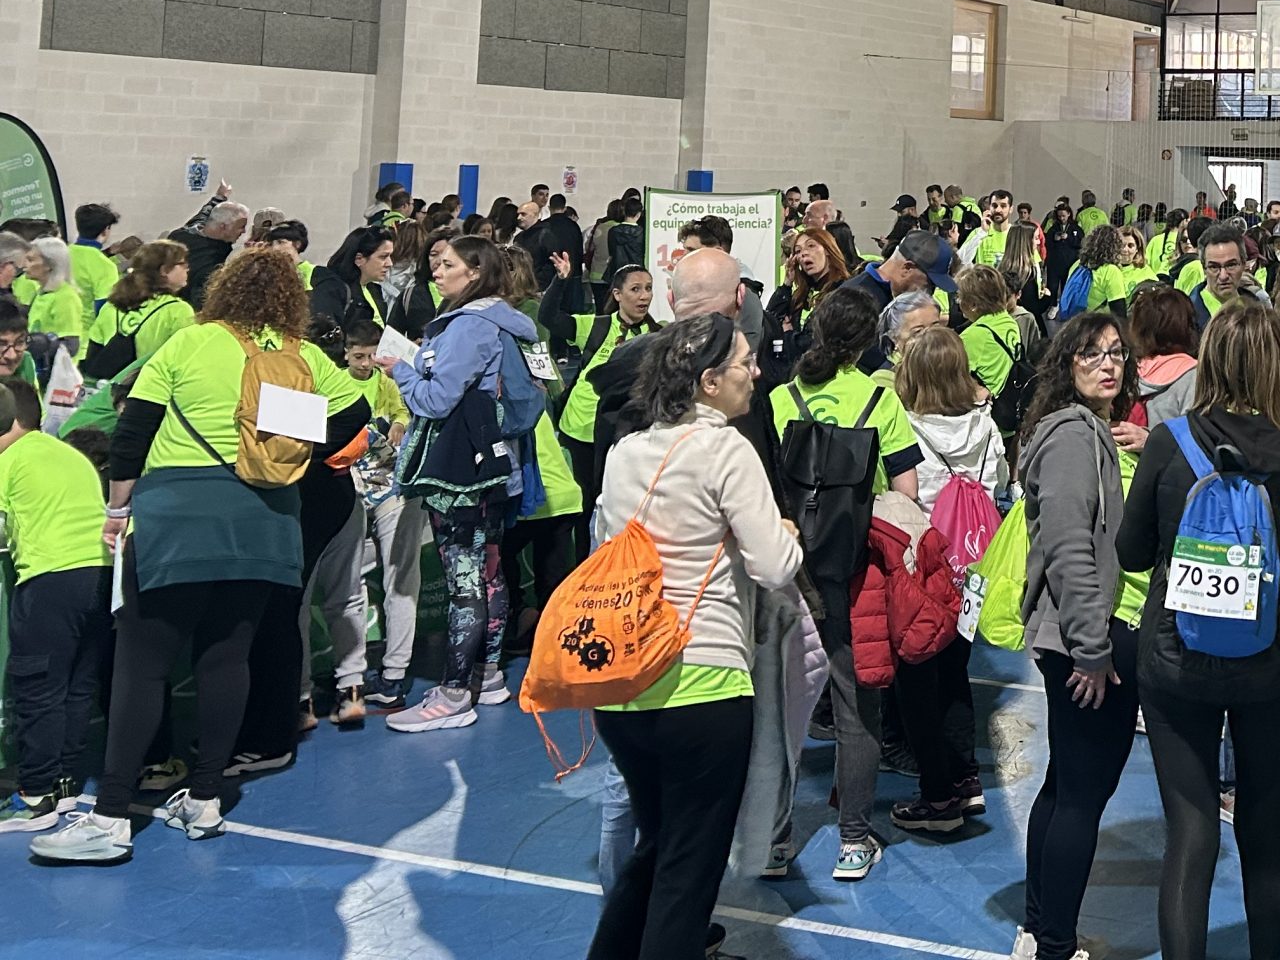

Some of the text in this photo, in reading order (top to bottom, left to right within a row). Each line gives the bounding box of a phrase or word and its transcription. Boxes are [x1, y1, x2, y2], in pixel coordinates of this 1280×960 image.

[666, 202, 760, 216] ¿Cómo trabaja el
[1176, 563, 1203, 586] 70
[1206, 574, 1240, 598] 30
[614, 589, 633, 610] 20
[566, 637, 577, 646] 20
[588, 648, 598, 661] G
